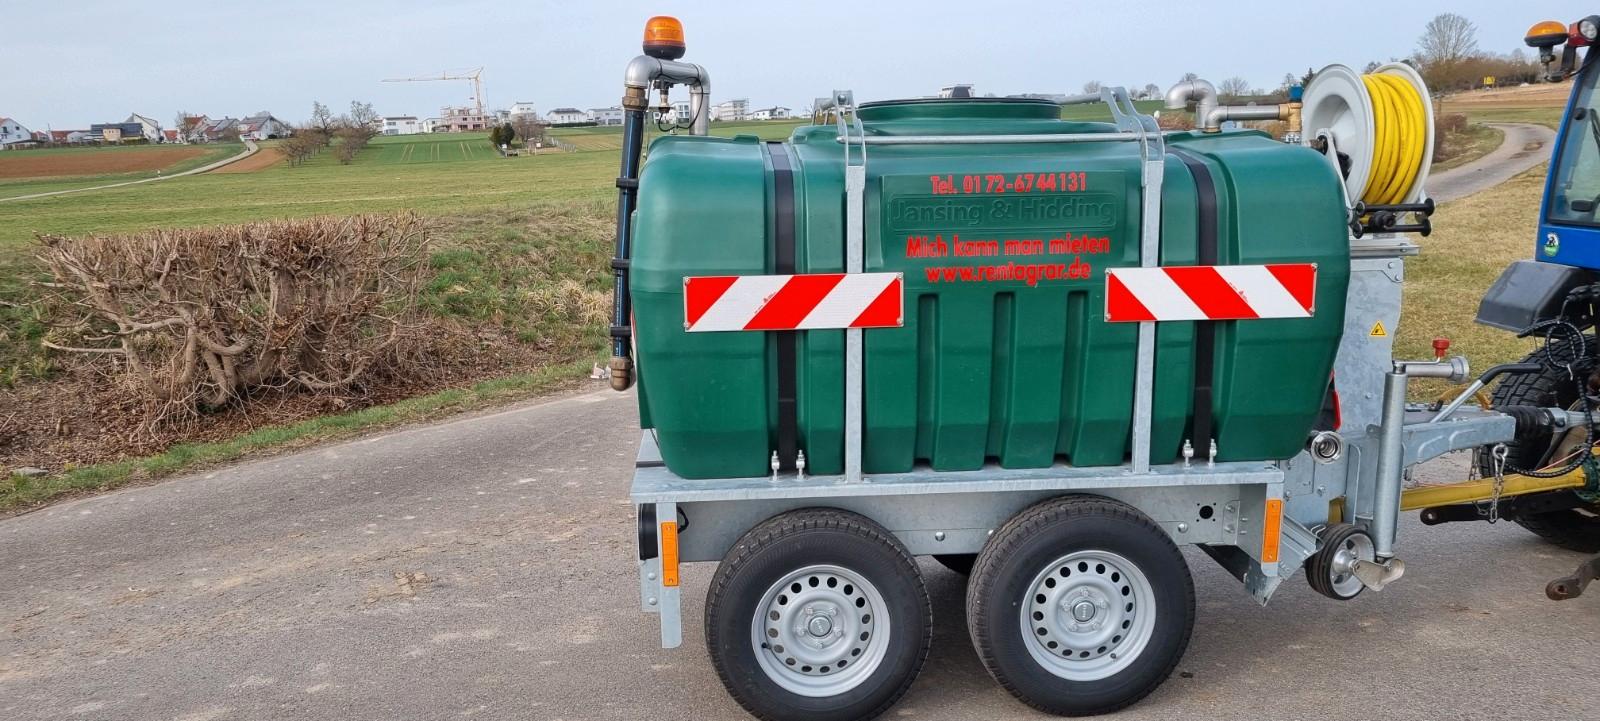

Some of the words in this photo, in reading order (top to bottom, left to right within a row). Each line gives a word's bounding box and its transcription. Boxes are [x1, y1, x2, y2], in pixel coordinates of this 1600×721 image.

[931, 175, 958, 195] Tel.
[894, 201, 984, 225] Jansing
[989, 200, 1014, 220] &
[1019, 197, 1115, 225] Hidding
[906, 235, 948, 257] Mich
[953, 235, 999, 257] kann
[1004, 239, 1044, 256] man
[1049, 233, 1110, 254] mieten
[925, 256, 1092, 286] www.rentagrar.de
